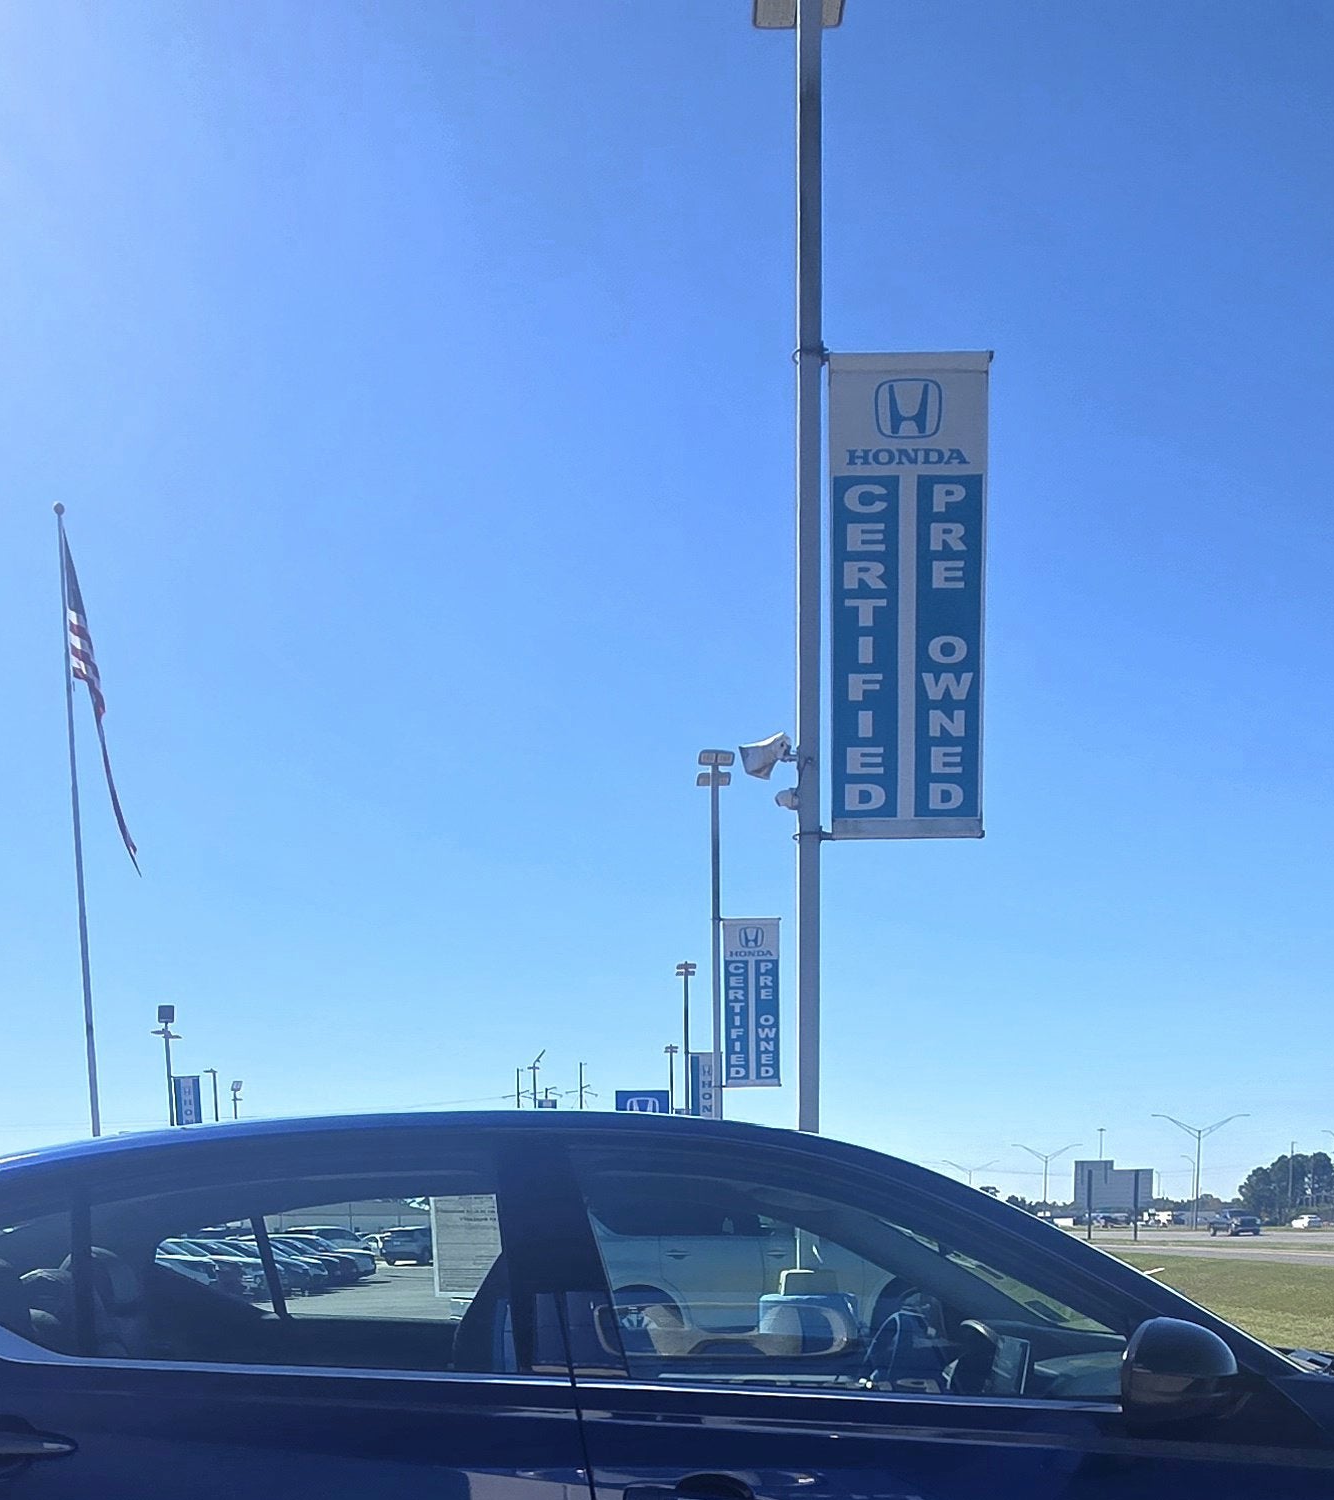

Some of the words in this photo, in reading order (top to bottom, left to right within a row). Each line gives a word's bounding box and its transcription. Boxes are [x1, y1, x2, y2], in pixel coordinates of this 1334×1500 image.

[846, 448, 970, 466] HONDA
[929, 484, 967, 589] PRE
[843, 484, 888, 811] CERTIFIED
[921, 635, 974, 810] OWNED
[728, 963, 746, 1077] CERTIFIED
[759, 962, 773, 1000] PRE
[758, 1015, 777, 1077] OWNED
[701, 1080, 713, 1113] HON
